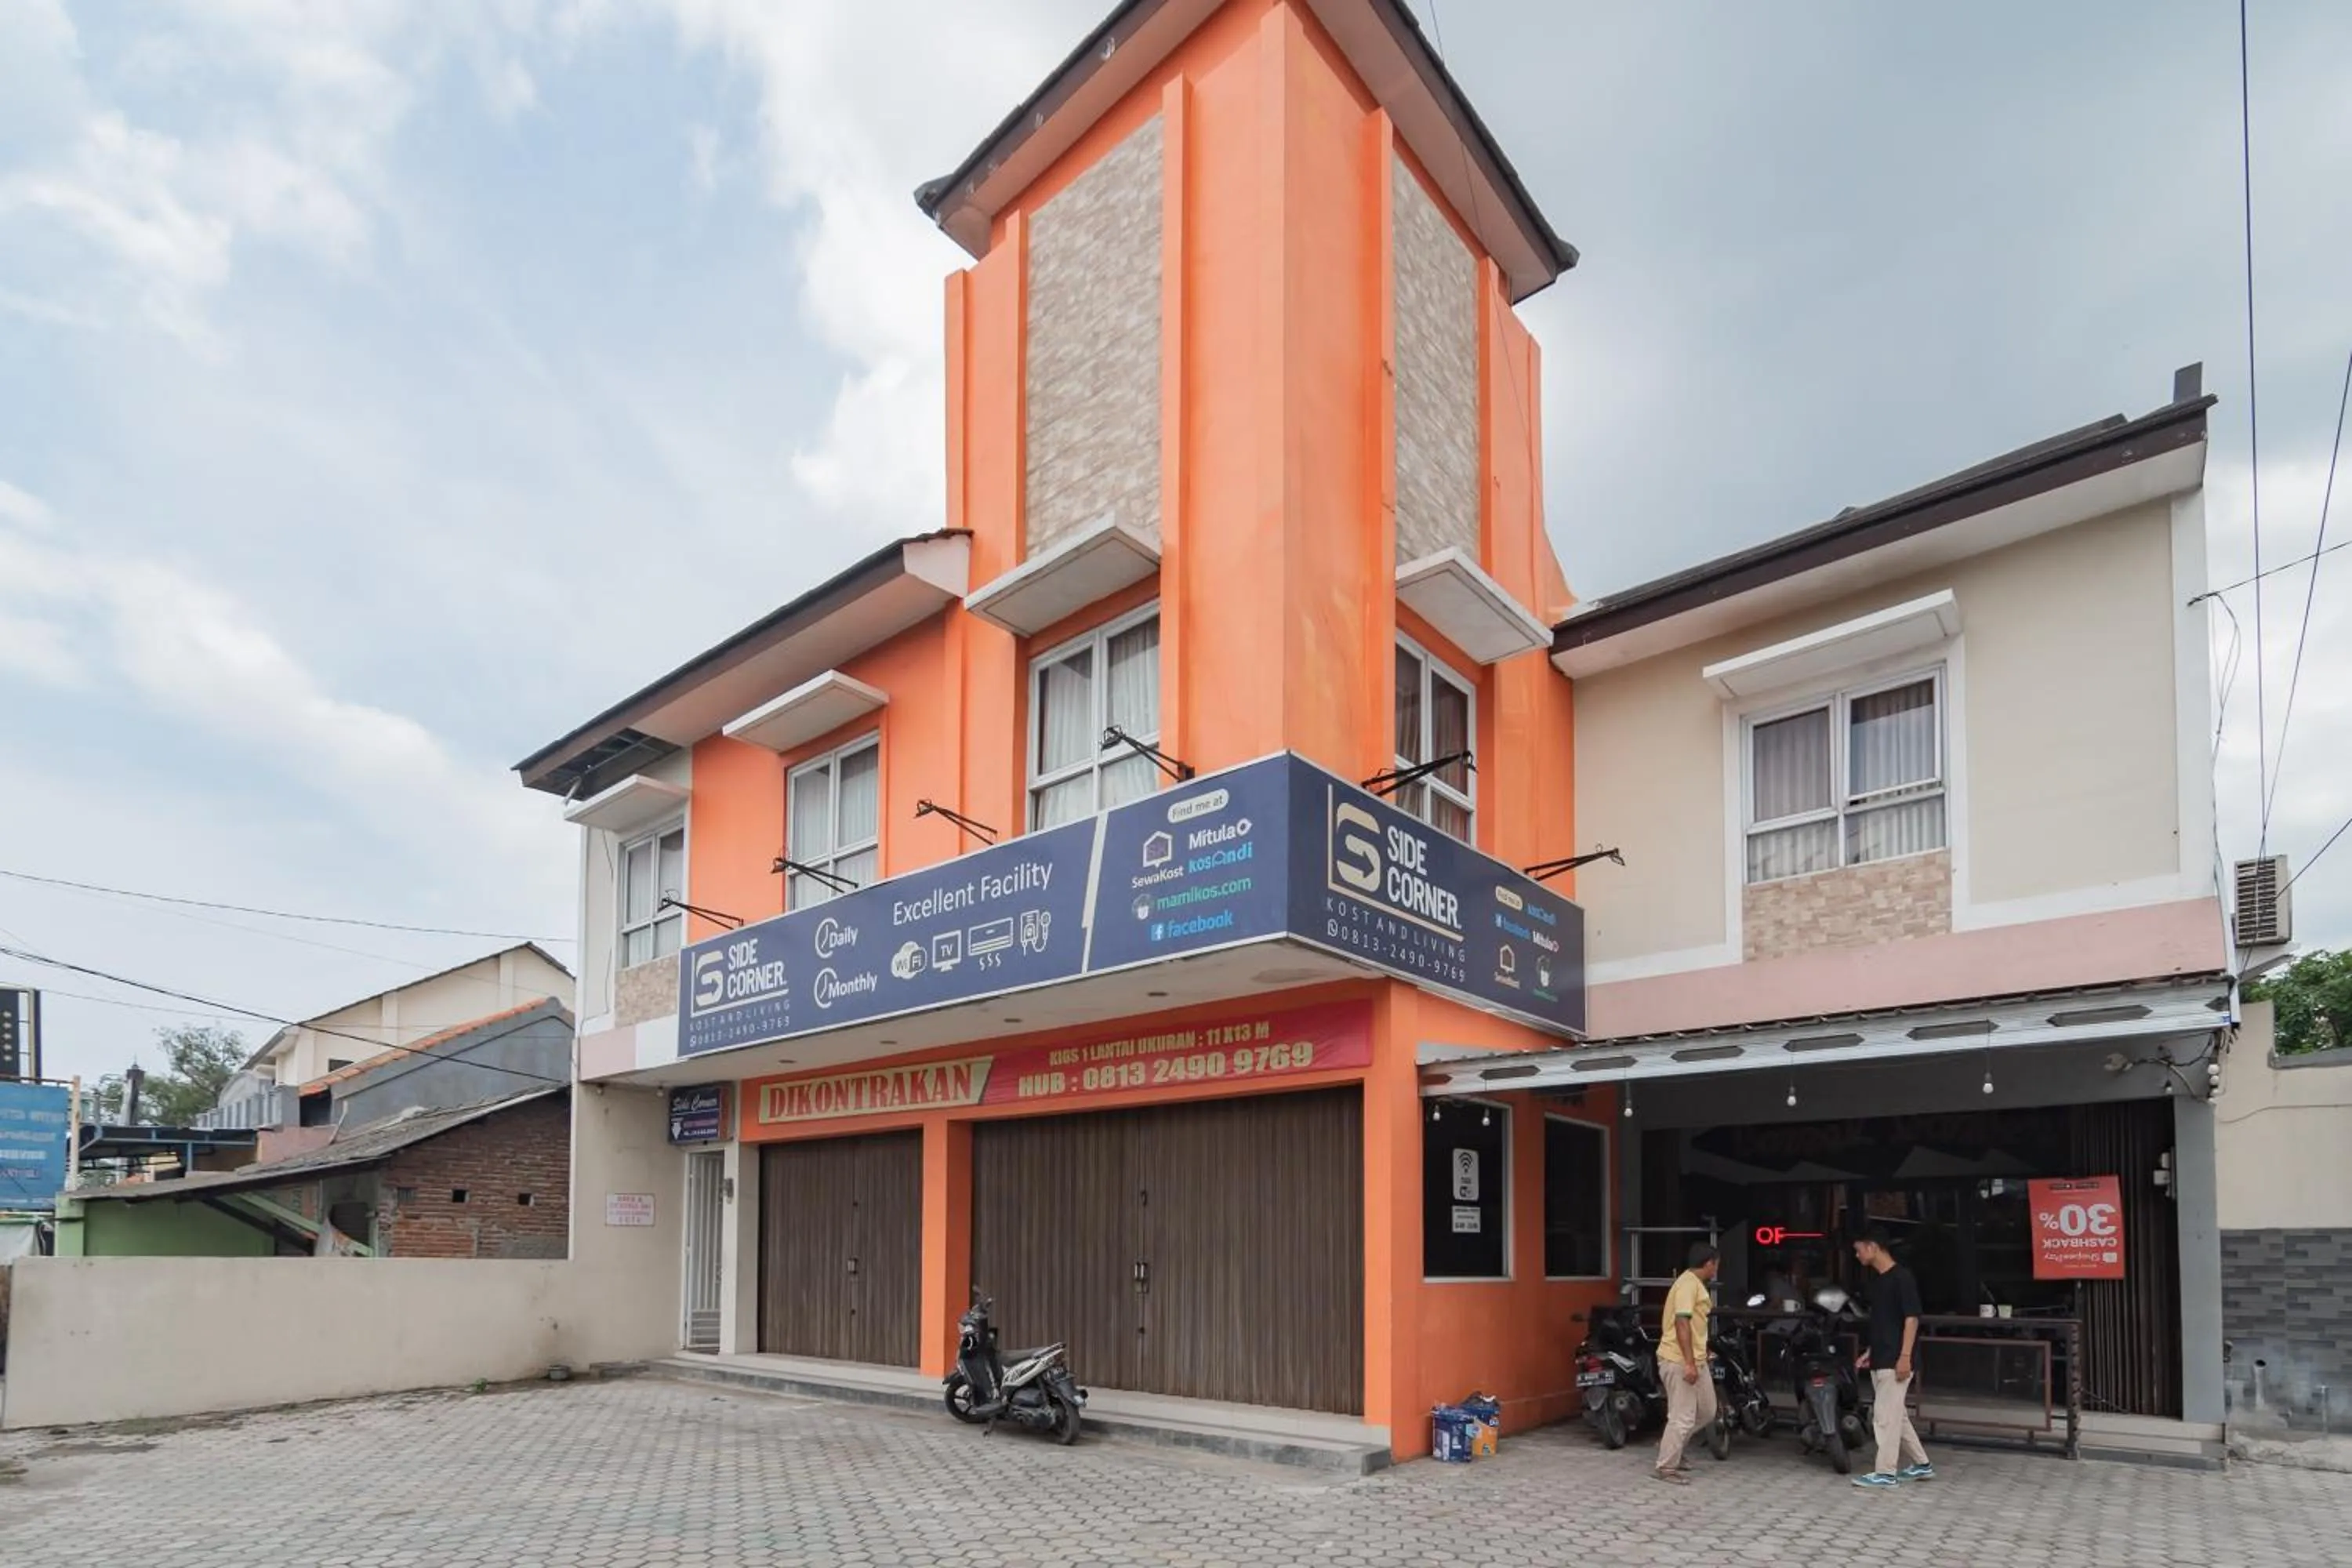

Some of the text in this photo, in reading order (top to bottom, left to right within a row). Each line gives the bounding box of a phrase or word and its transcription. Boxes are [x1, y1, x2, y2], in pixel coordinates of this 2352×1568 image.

[1172, 794, 1224, 819] Find me at
[1386, 825, 1428, 877] SIDE
[1131, 865, 1185, 889] SewaKost
[893, 862, 1054, 926] Excellent Facility
[1157, 877, 1252, 911] mamikos.com
[829, 927, 858, 949] Daily
[1167, 909, 1233, 938] facebook
[728, 938, 759, 971] SIDE
[941, 944, 954, 957] TV
[829, 972, 878, 999] Monthly
[1091, 1039, 1134, 1058] LANTAI
[1138, 1030, 1196, 1054] UKURAN
[1255, 1022, 1269, 1040] M
[1018, 1073, 1066, 1098] HUB
[1083, 1062, 1146, 1091] 0813
[1152, 1051, 1225, 1083] 2490
[1233, 1041, 1314, 1072] 9769
[769, 1063, 971, 1119] DIKONTRAKAN
[2038, 1203, 2117, 1236] 30%
[2042, 1236, 2118, 1249] CASHBACK
